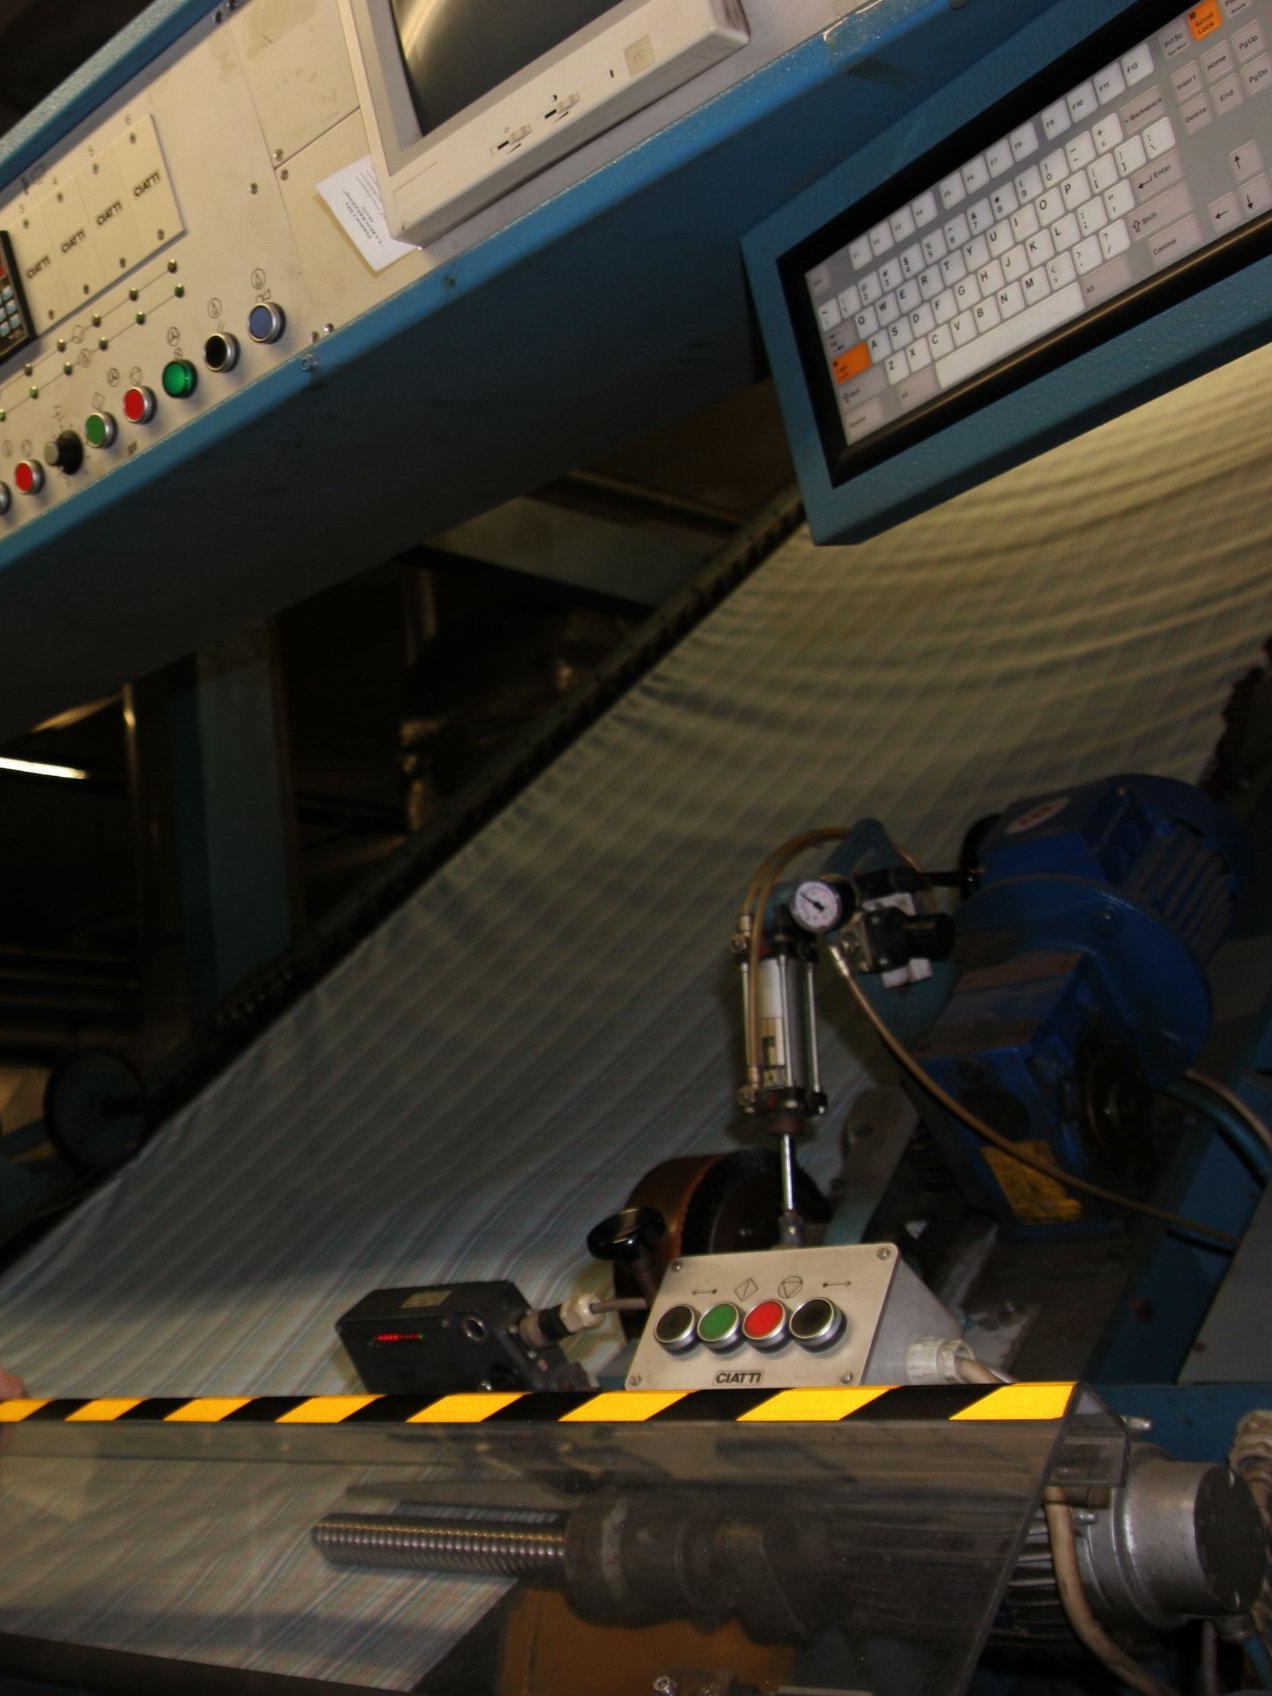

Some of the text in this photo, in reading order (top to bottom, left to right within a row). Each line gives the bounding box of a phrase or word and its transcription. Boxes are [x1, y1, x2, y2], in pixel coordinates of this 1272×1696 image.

[1194, 12, 1215, 27] Scroll
[1198, 21, 1214, 35] Lock
[1127, 63, 1139, 73] F12
[1207, 56, 1227, 70] Home
[1249, 69, 1269, 83] PgDn
[1098, 82, 1110, 92] F11
[1177, 75, 1197, 90] Insert
[1220, 90, 1234, 102] End
[1071, 100, 1084, 110] F10
[1129, 98, 1163, 121] Backspace
[1185, 108, 1208, 123] Delete
[1153, 165, 1172, 178] Enter
[133, 170, 161, 197] CIATTI
[1065, 184, 1072, 194] P
[1039, 200, 1048, 210] O
[96, 201, 123, 226] CIATTI
[1142, 213, 1158, 225] Shift
[61, 229, 86, 253] CIATTI
[989, 230, 998, 242] U
[966, 246, 973, 255] Y
[1030, 241, 1038, 252] K
[1153, 238, 1177, 255] Control
[943, 260, 950, 270] T
[1006, 257, 1012, 267] J
[26, 256, 51, 279] CIATTI
[921, 276, 929, 285] R
[980, 272, 989, 281] H
[1025, 278, 1034, 289] M
[900, 290, 906, 299] E
[958, 286, 966, 295] G
[1001, 294, 1009, 303] N
[879, 302, 888, 311] W
[935, 300, 941, 310] F
[977, 308, 985, 318] B
[858, 316, 866, 326] Q
[912, 313, 920, 324] D
[891, 326, 899, 336] S
[872, 340, 878, 349] A
[932, 335, 939, 344] C
[910, 348, 917, 357] X
[888, 361, 896, 371] Z
[716, 1372, 763, 1383] CIATTI
